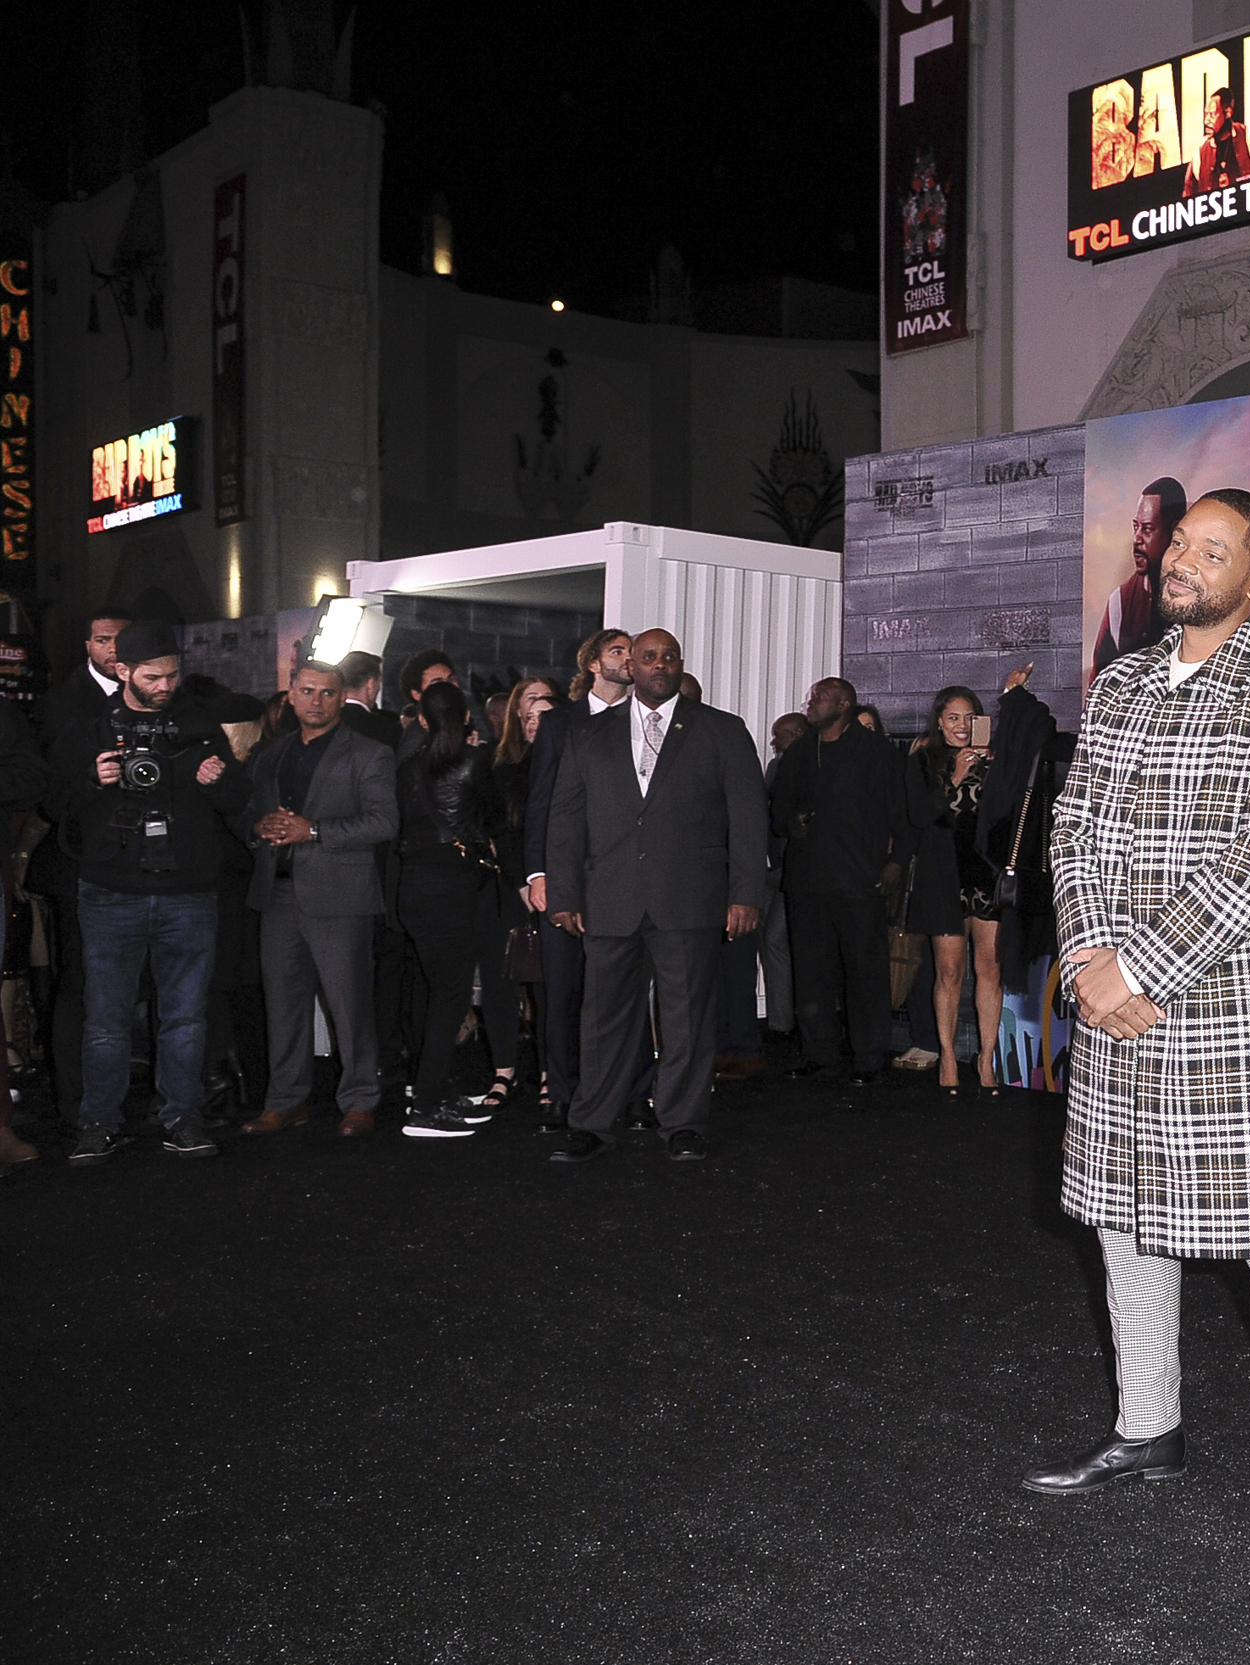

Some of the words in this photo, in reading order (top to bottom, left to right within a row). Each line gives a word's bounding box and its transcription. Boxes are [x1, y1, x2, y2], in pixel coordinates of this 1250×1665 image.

[1091, 47, 1230, 190] BAD
[1068, 220, 1129, 256] TCL
[1132, 185, 1238, 240] CHINESE
[904, 260, 945, 286] TCL
[904, 282, 945, 303] CHINESE
[904, 295, 945, 313] THEATRES
[897, 310, 952, 339] IMAX
[0, 260, 31, 560] CHINESE
[984, 457, 1049, 485] IMAX
